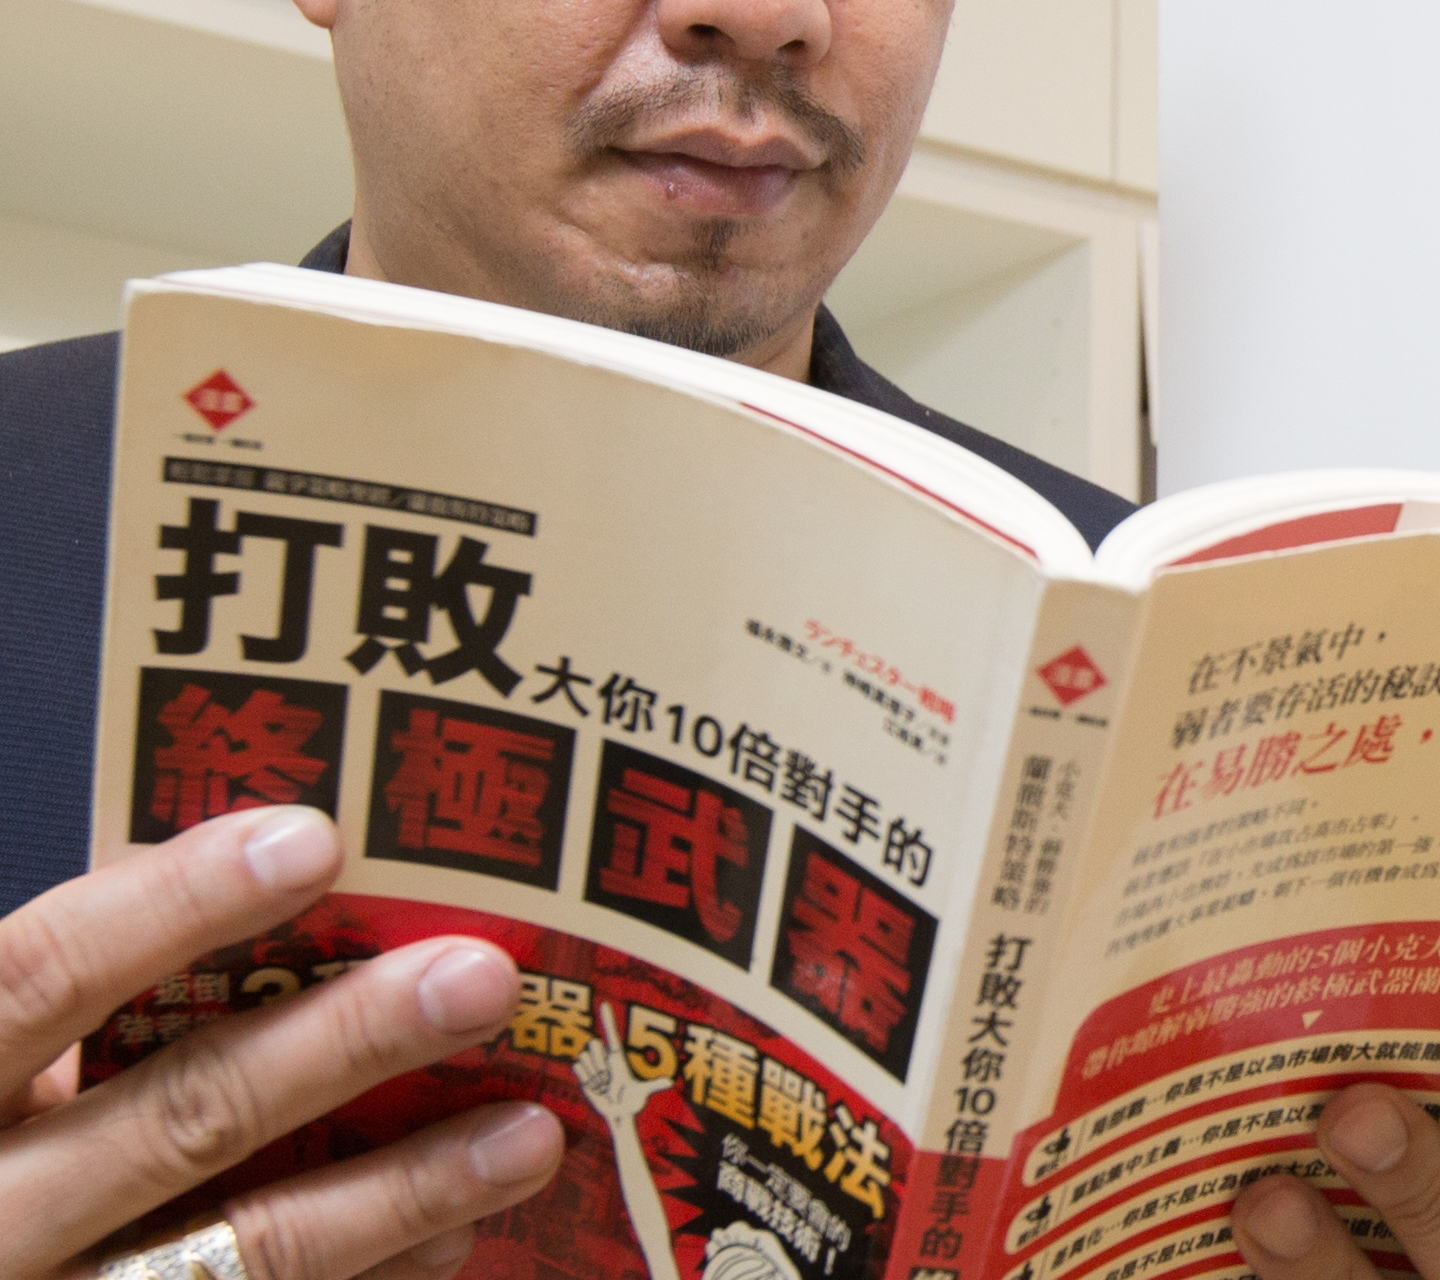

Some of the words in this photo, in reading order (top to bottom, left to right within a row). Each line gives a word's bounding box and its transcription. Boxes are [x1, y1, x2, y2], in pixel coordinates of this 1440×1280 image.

[151, 497, 536, 698] 打敗
[150, 683, 914, 1048] 終極武器
[532, 655, 934, 888] 大你10倍對手的
[626, 1014, 888, 1219] 5種戰法
